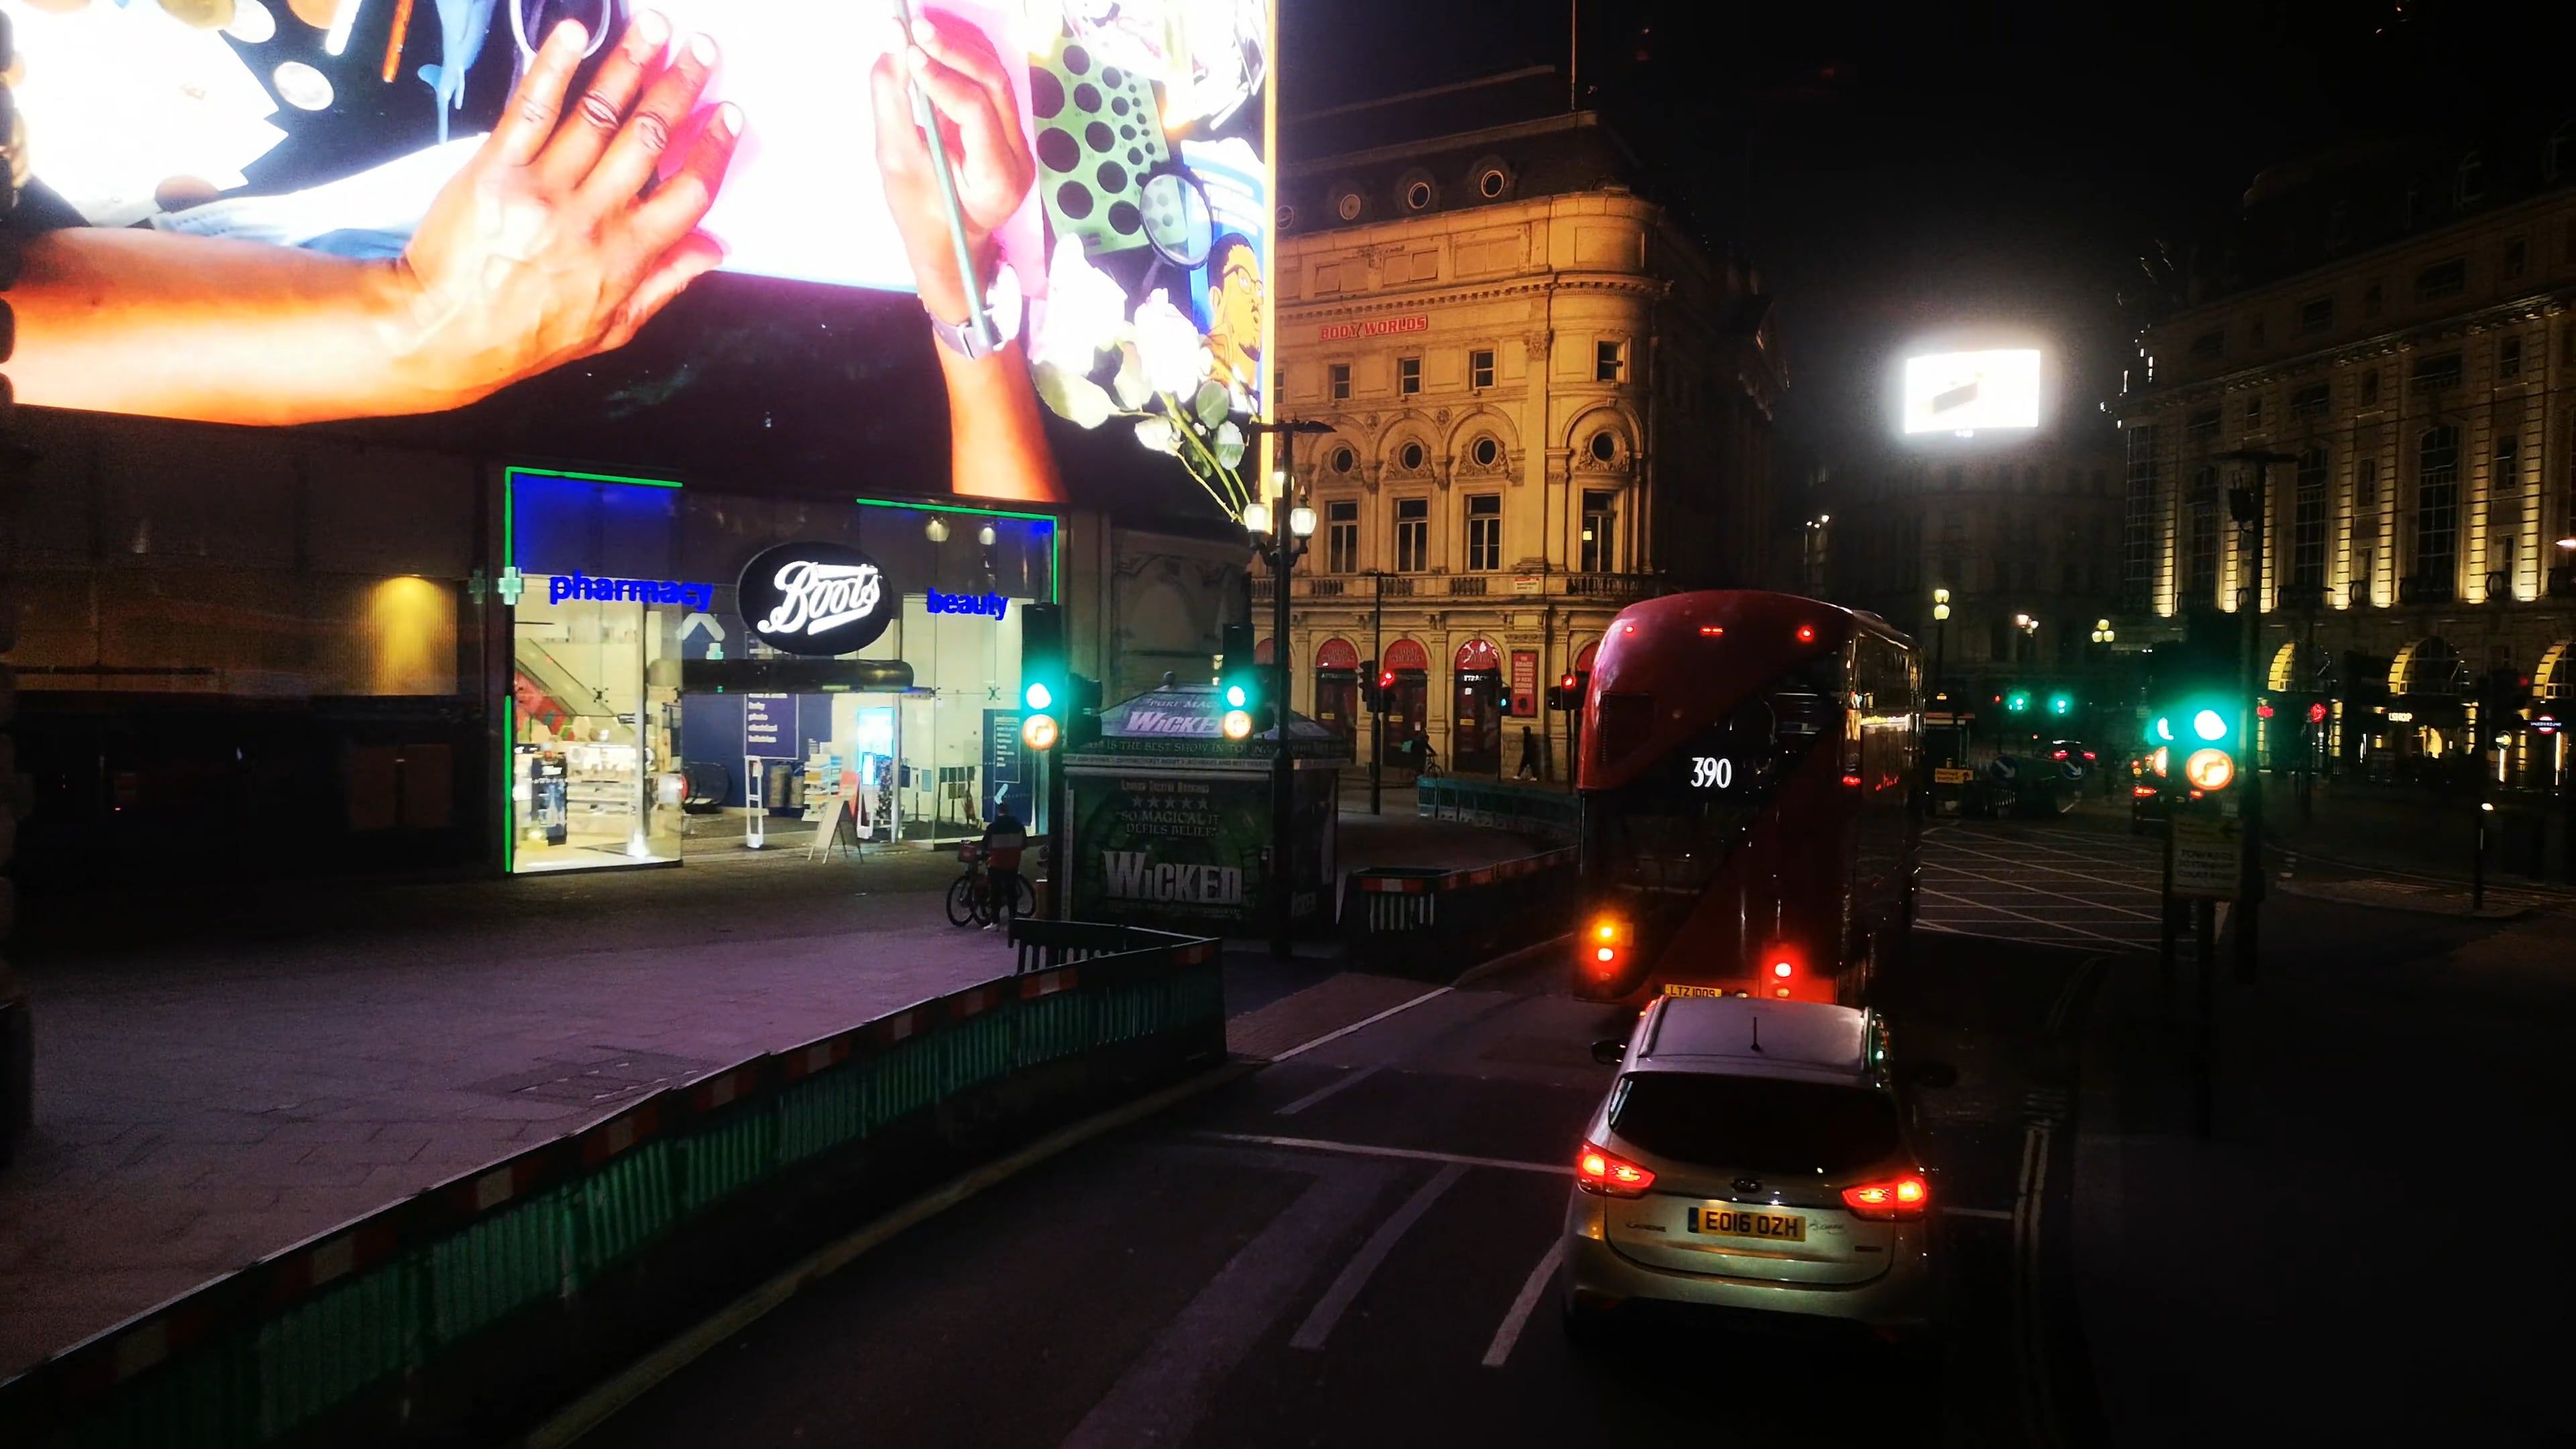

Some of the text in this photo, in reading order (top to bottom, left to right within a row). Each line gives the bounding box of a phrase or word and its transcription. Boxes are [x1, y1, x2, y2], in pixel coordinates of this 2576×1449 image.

[1322, 317, 1426, 339] BODY WORLDS
[549, 570, 714, 612] pharmacy
[757, 561, 881, 635] Boots
[926, 587, 1009, 621] beauty
[1120, 741, 1141, 751] THE
[1144, 741, 1171, 752] BEST
[1174, 742, 1208, 753] SHOW
[1212, 743, 1224, 753] IN
[1690, 757, 1732, 788] 390
[1126, 822, 1168, 835] DEFIES
[1142, 810, 1206, 825] MAGICAL
[1209, 814, 1220, 824] IT
[1670, 985, 1690, 997] LTZ
[1706, 1211, 1751, 1233] EO16
[1758, 1215, 1798, 1237] OZH
